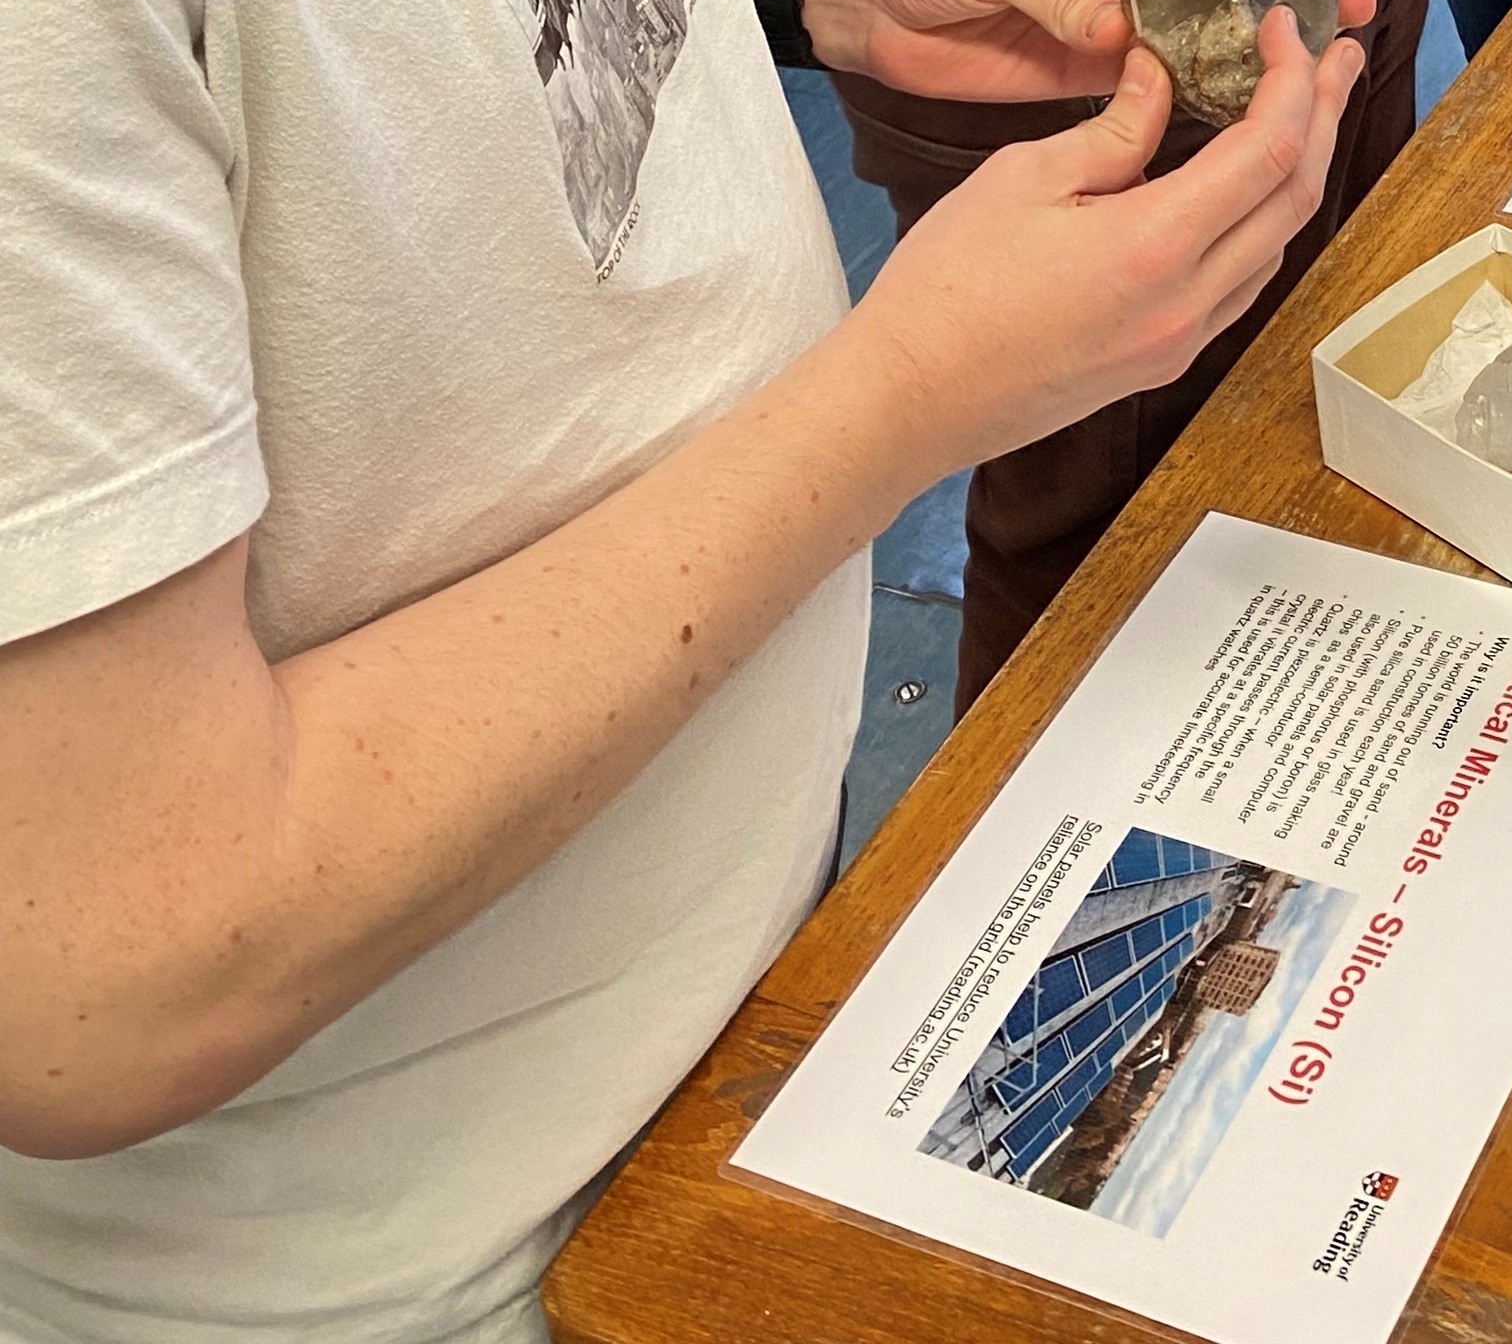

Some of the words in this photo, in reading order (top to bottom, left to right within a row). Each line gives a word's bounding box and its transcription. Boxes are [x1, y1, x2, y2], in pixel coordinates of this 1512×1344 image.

[1477, 662, 1492, 672] is
[1482, 637, 1509, 661] Why
[1469, 675, 1485, 683] it
[1431, 685, 1478, 749] important?
[1402, 747, 1498, 875] Minerals
[1034, 815, 1078, 870] reliance
[1065, 821, 1104, 861] Solar
[1000, 896, 1025, 919] the
[1018, 873, 1037, 892] on
[1027, 859, 1077, 911] panels
[977, 923, 1003, 953] grid
[1002, 911, 1042, 947] help
[992, 948, 1016, 966] to
[1313, 912, 1403, 1030] Silicon
[889, 955, 984, 1073] (reading.ac.uk)
[953, 967, 1005, 1024] reduce
[883, 1024, 965, 1121] University's
[1267, 1040, 1332, 1105] (Si)
[1311, 1197, 1369, 1274] Reading
[1341, 1203, 1383, 1265] University
[1336, 1266, 1347, 1281] of
